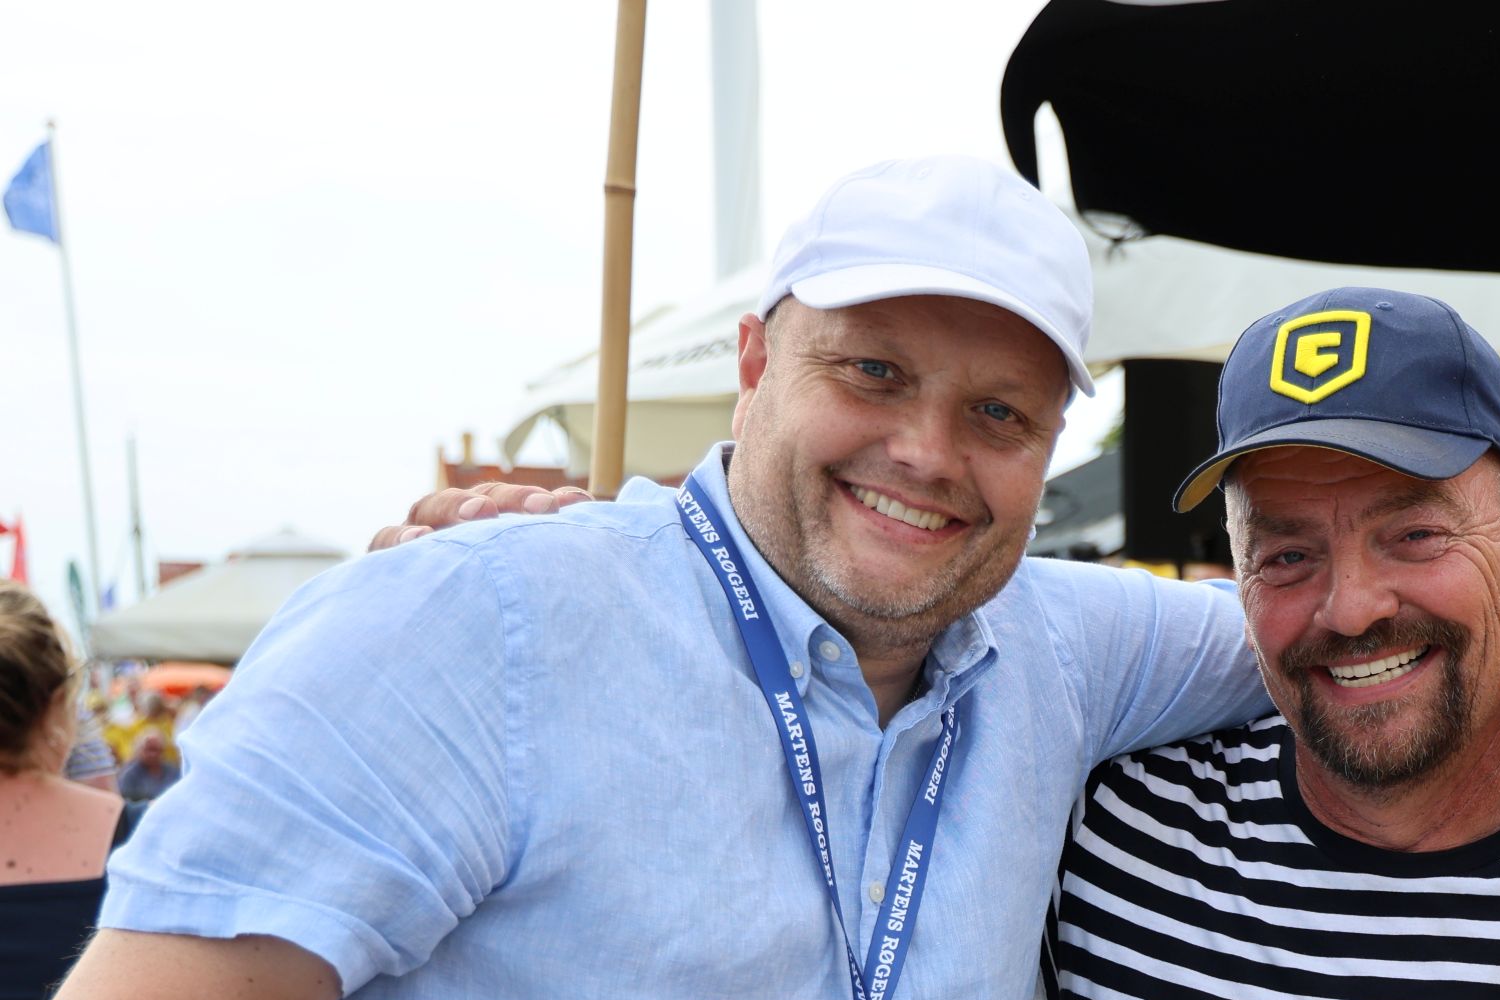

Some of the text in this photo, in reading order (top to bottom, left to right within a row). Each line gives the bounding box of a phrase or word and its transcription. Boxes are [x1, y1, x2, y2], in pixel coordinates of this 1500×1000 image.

[711, 546, 760, 621] RØGERI
[774, 691, 817, 796] MARTENS
[887, 839, 924, 932] MARTENS
